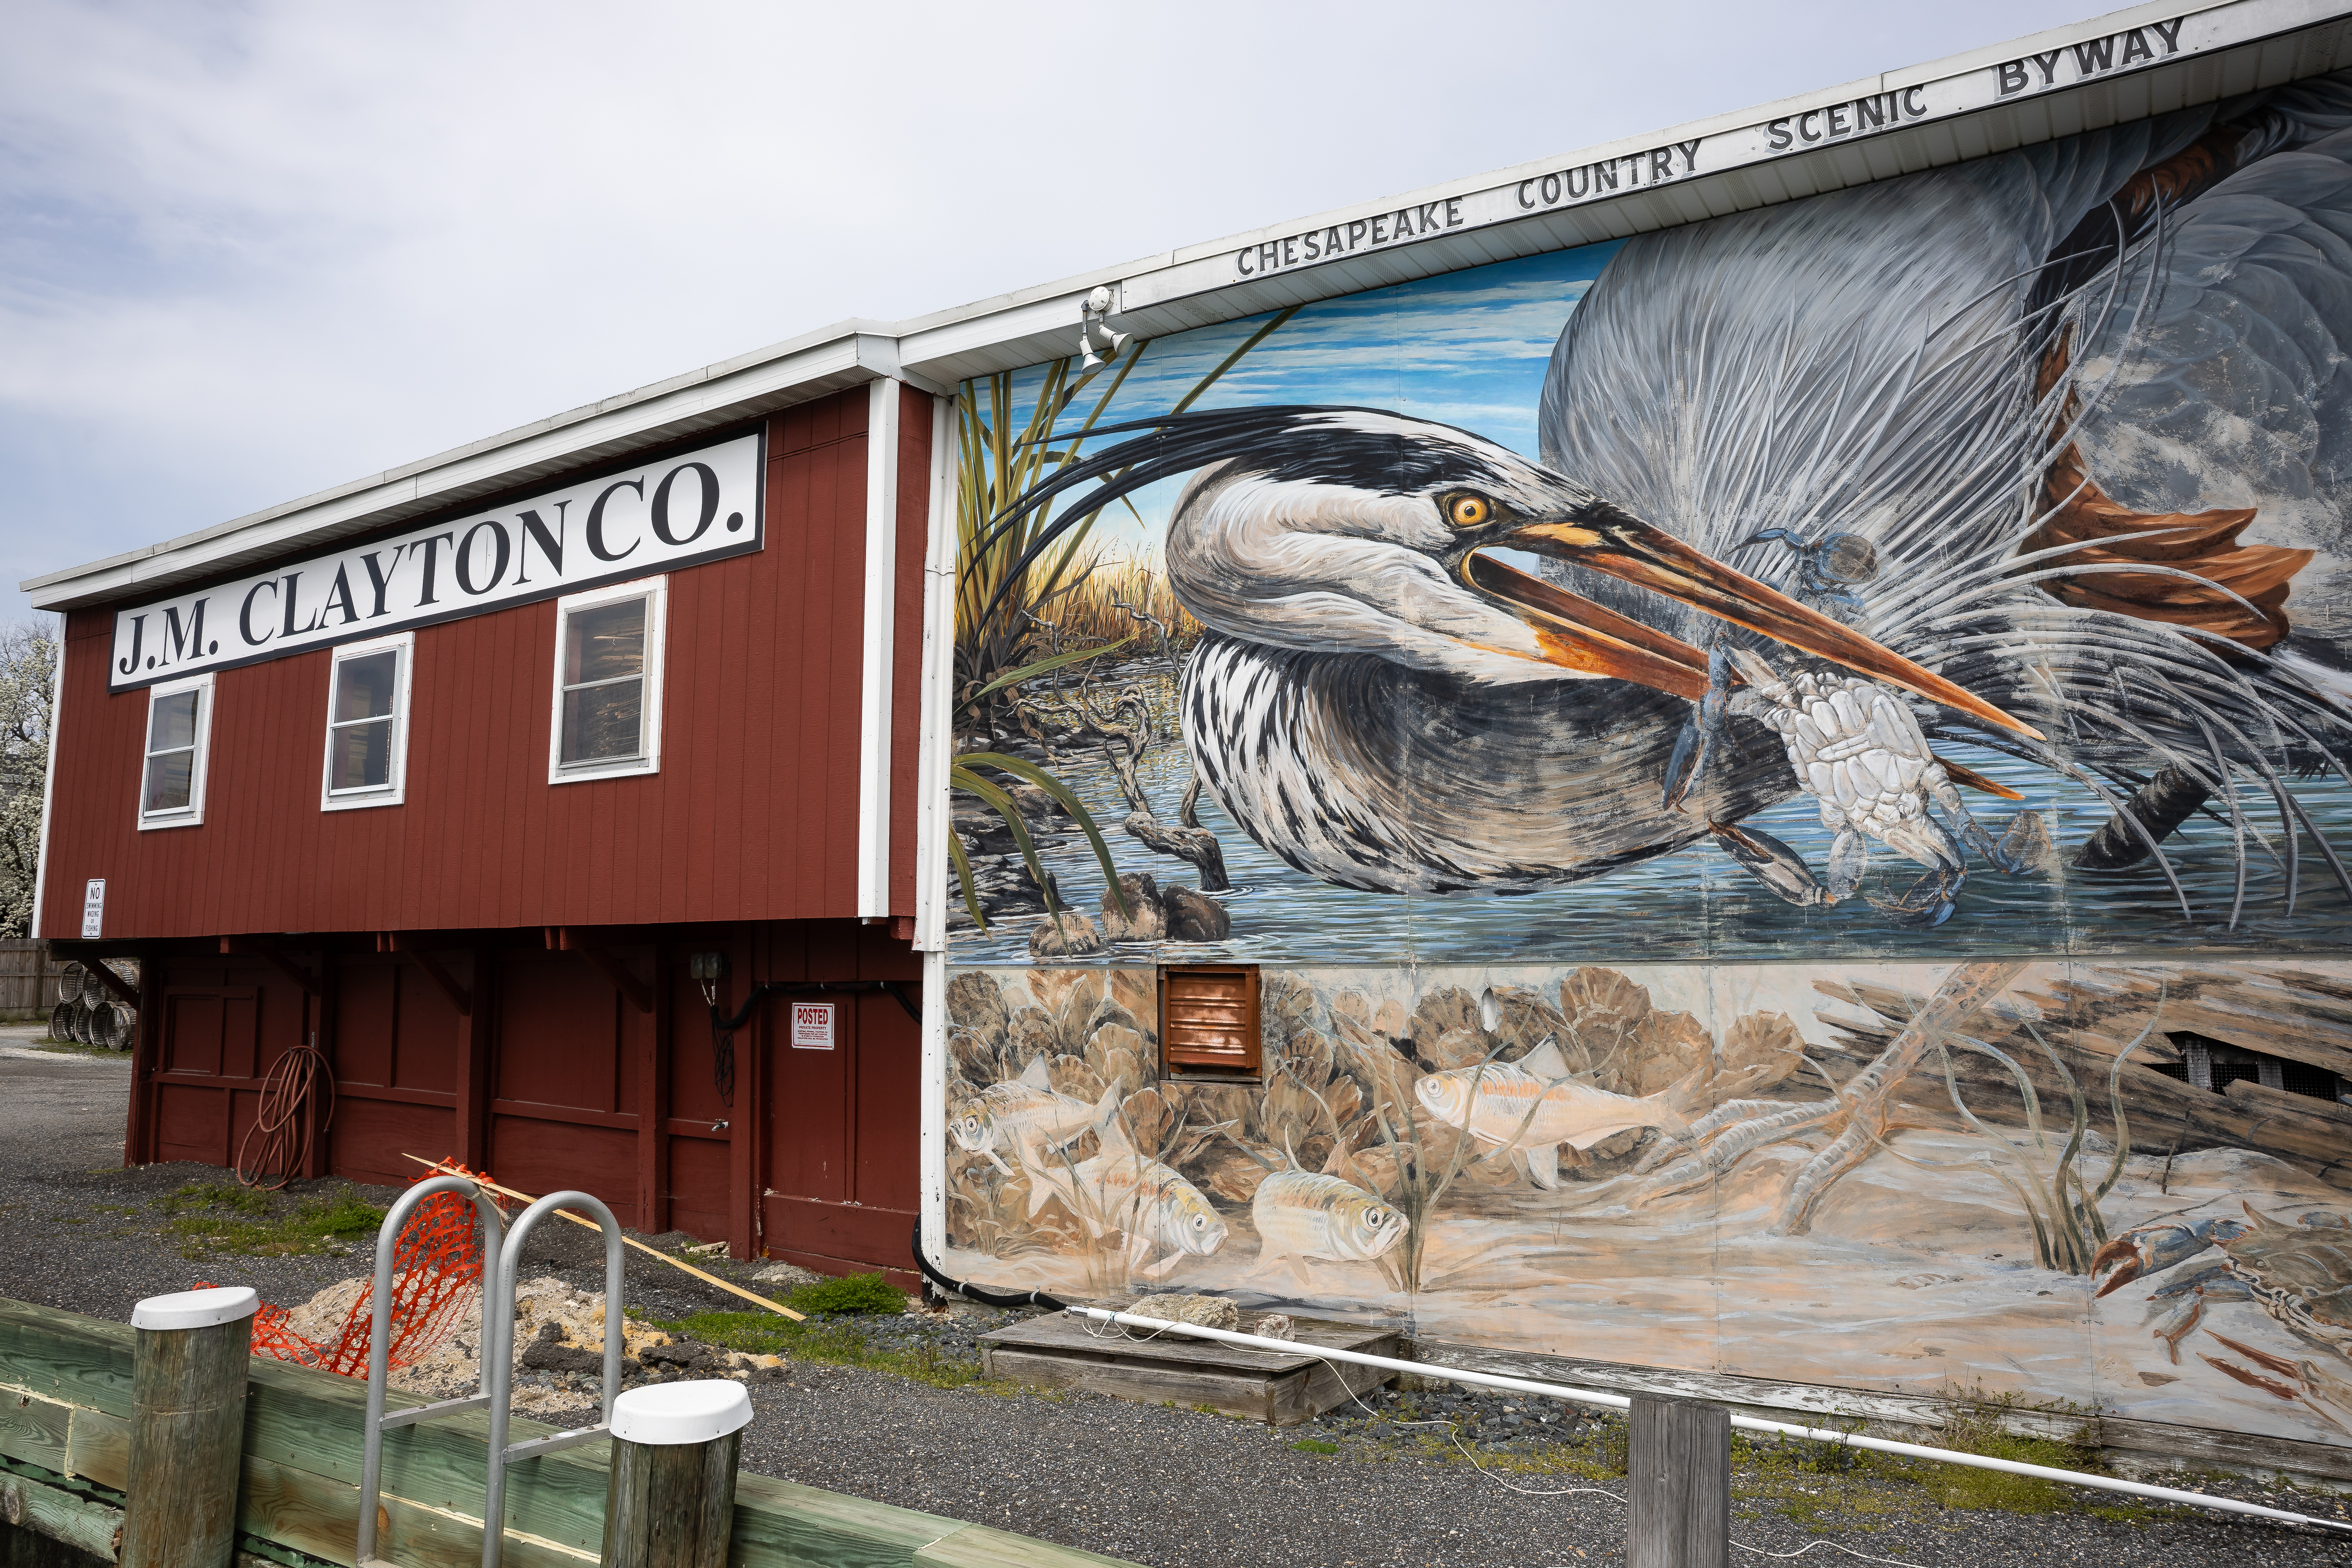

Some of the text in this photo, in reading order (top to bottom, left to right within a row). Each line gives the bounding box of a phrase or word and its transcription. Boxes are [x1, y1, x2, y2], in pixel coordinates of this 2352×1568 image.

[1237, 196, 1464, 277] CHESAPEAKE
[1517, 137, 1703, 210] COUNTRY
[1766, 85, 1928, 151] SCENIC
[119, 462, 744, 675] J.M. CLAYTON CO.
[90, 887, 100, 899] NO
[797, 1008, 828, 1025] POSTED
